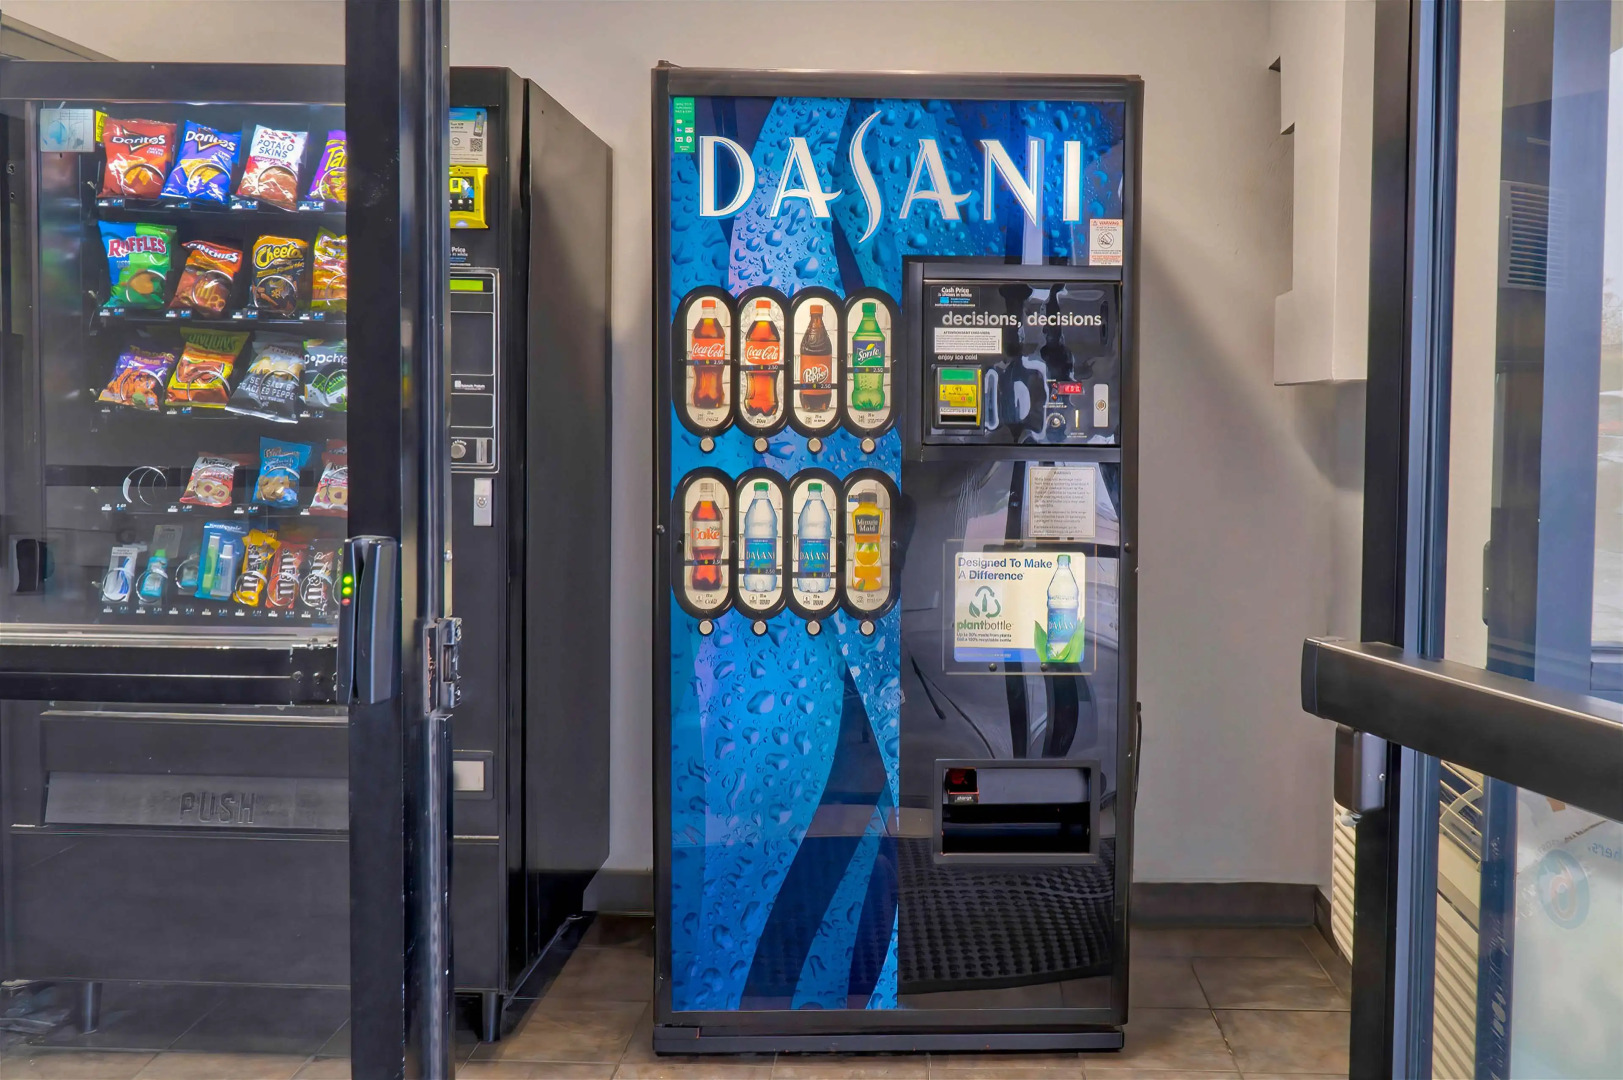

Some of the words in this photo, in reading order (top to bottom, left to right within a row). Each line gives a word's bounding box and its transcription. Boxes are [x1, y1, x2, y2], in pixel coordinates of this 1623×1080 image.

[112, 134, 166, 145] Doritos
[184, 130, 237, 151] Doritos
[258, 147, 288, 159] SKINS
[699, 110, 1085, 244] DASANI
[942, 311, 1022, 328] decisions,
[1027, 311, 1102, 326] decisions
[858, 347, 880, 361] Sprite
[272, 388, 297, 401] PEPPE
[691, 527, 720, 540] Coke
[746, 549, 776, 560] DASANI
[799, 550, 830, 560] DASANI
[958, 557, 1007, 569] Designed
[1009, 558, 1022, 568] To
[1024, 559, 1053, 568] Make
[958, 570, 967, 580] A
[969, 570, 1024, 581] Difference
[956, 619, 1012, 632] plantbottle
[180, 791, 255, 824] PUSH
